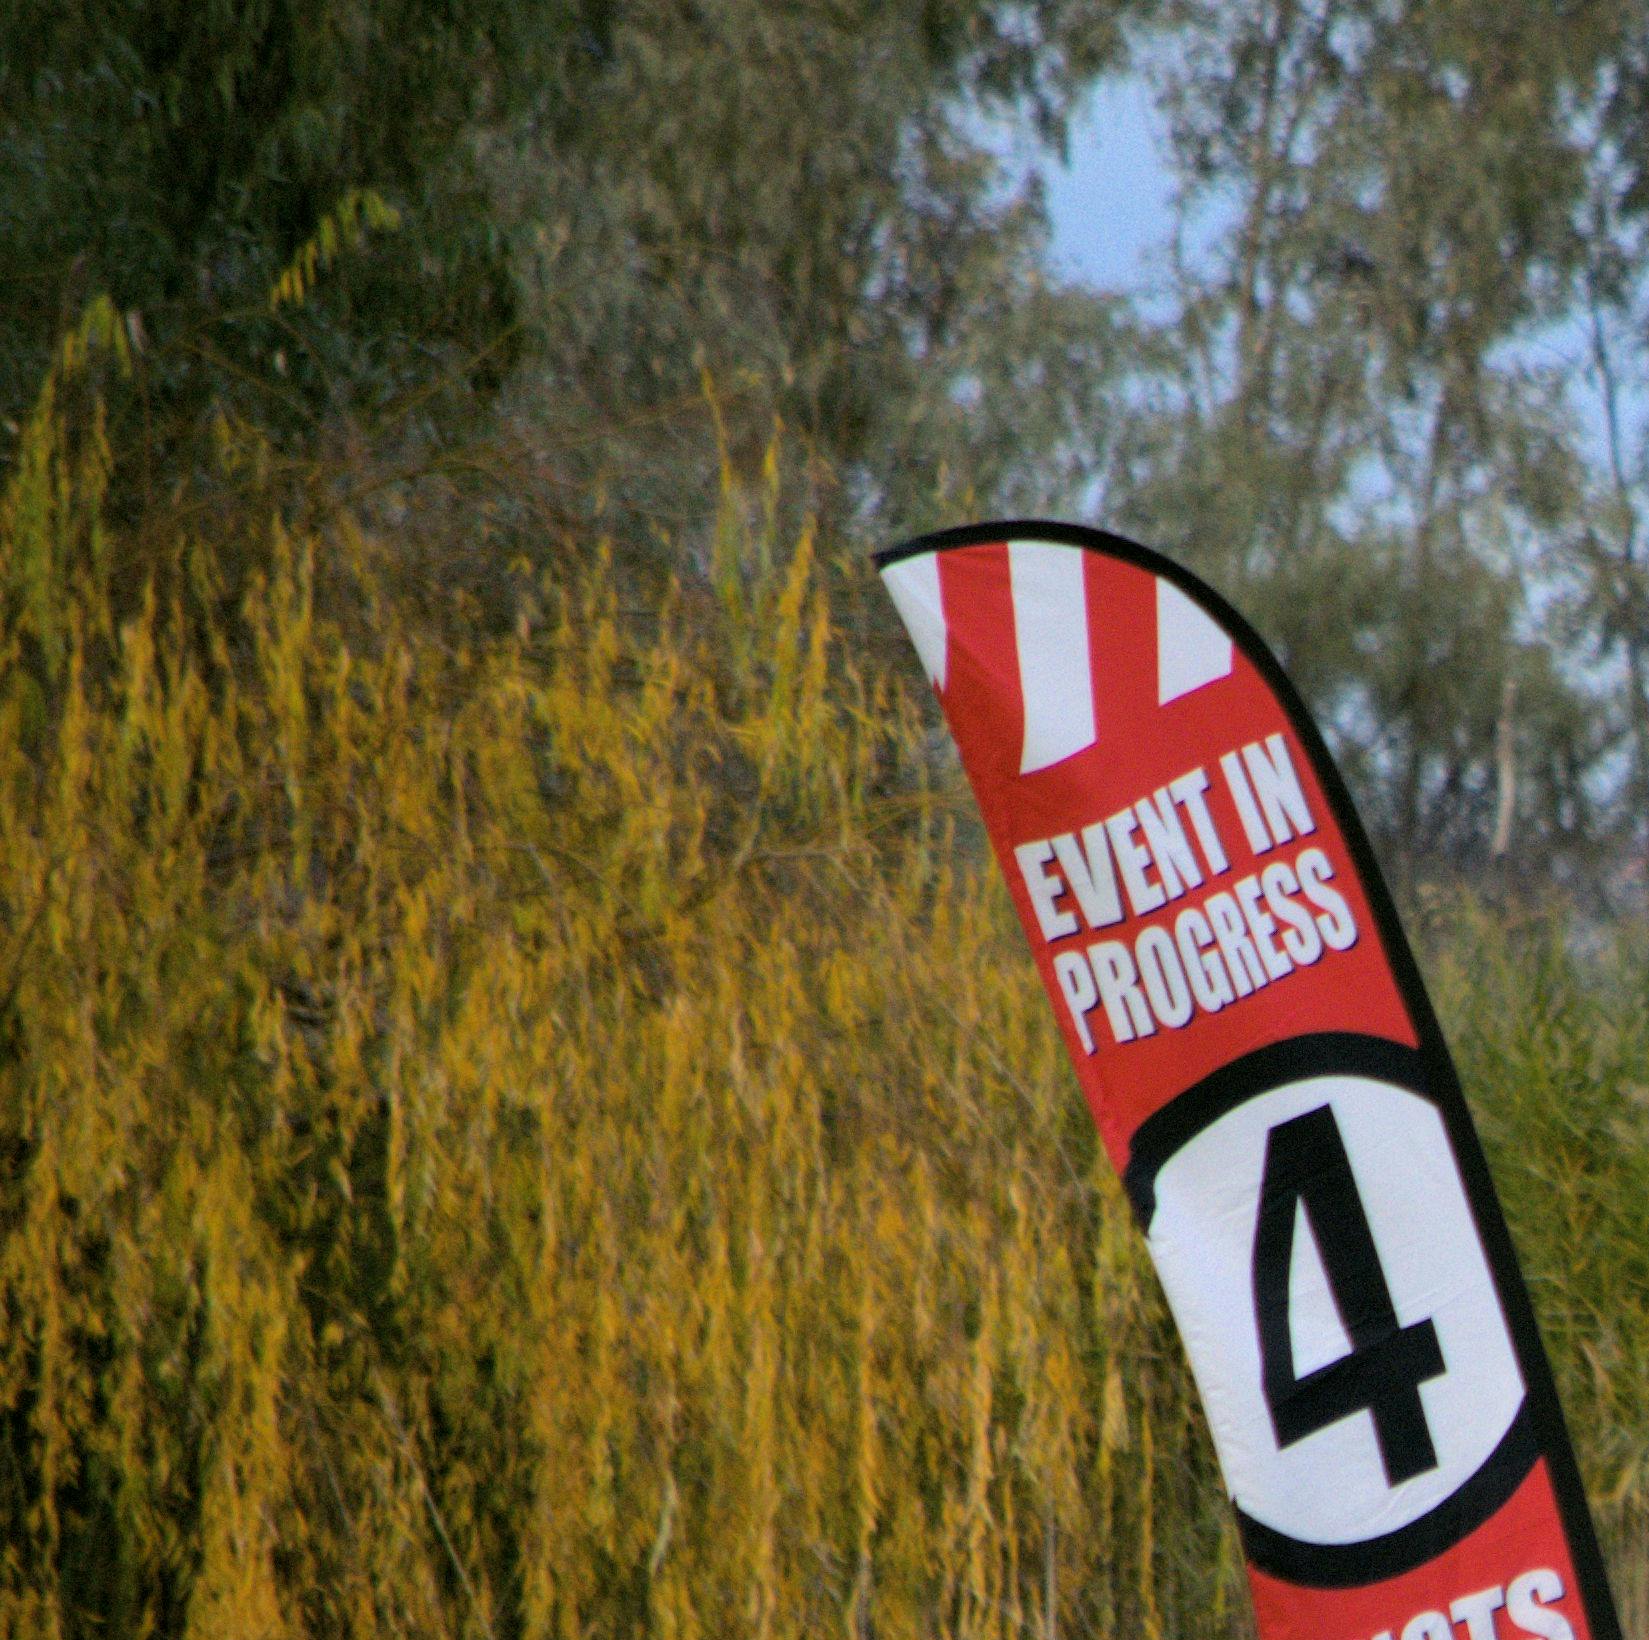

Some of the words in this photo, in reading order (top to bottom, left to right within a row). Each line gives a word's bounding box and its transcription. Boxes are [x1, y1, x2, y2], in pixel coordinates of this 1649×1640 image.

[1015, 766, 1230, 943] EVENT
[1220, 733, 1316, 855] IN
[1054, 848, 1358, 1056] PROGRESS
[1251, 1102, 1448, 1488] 4
